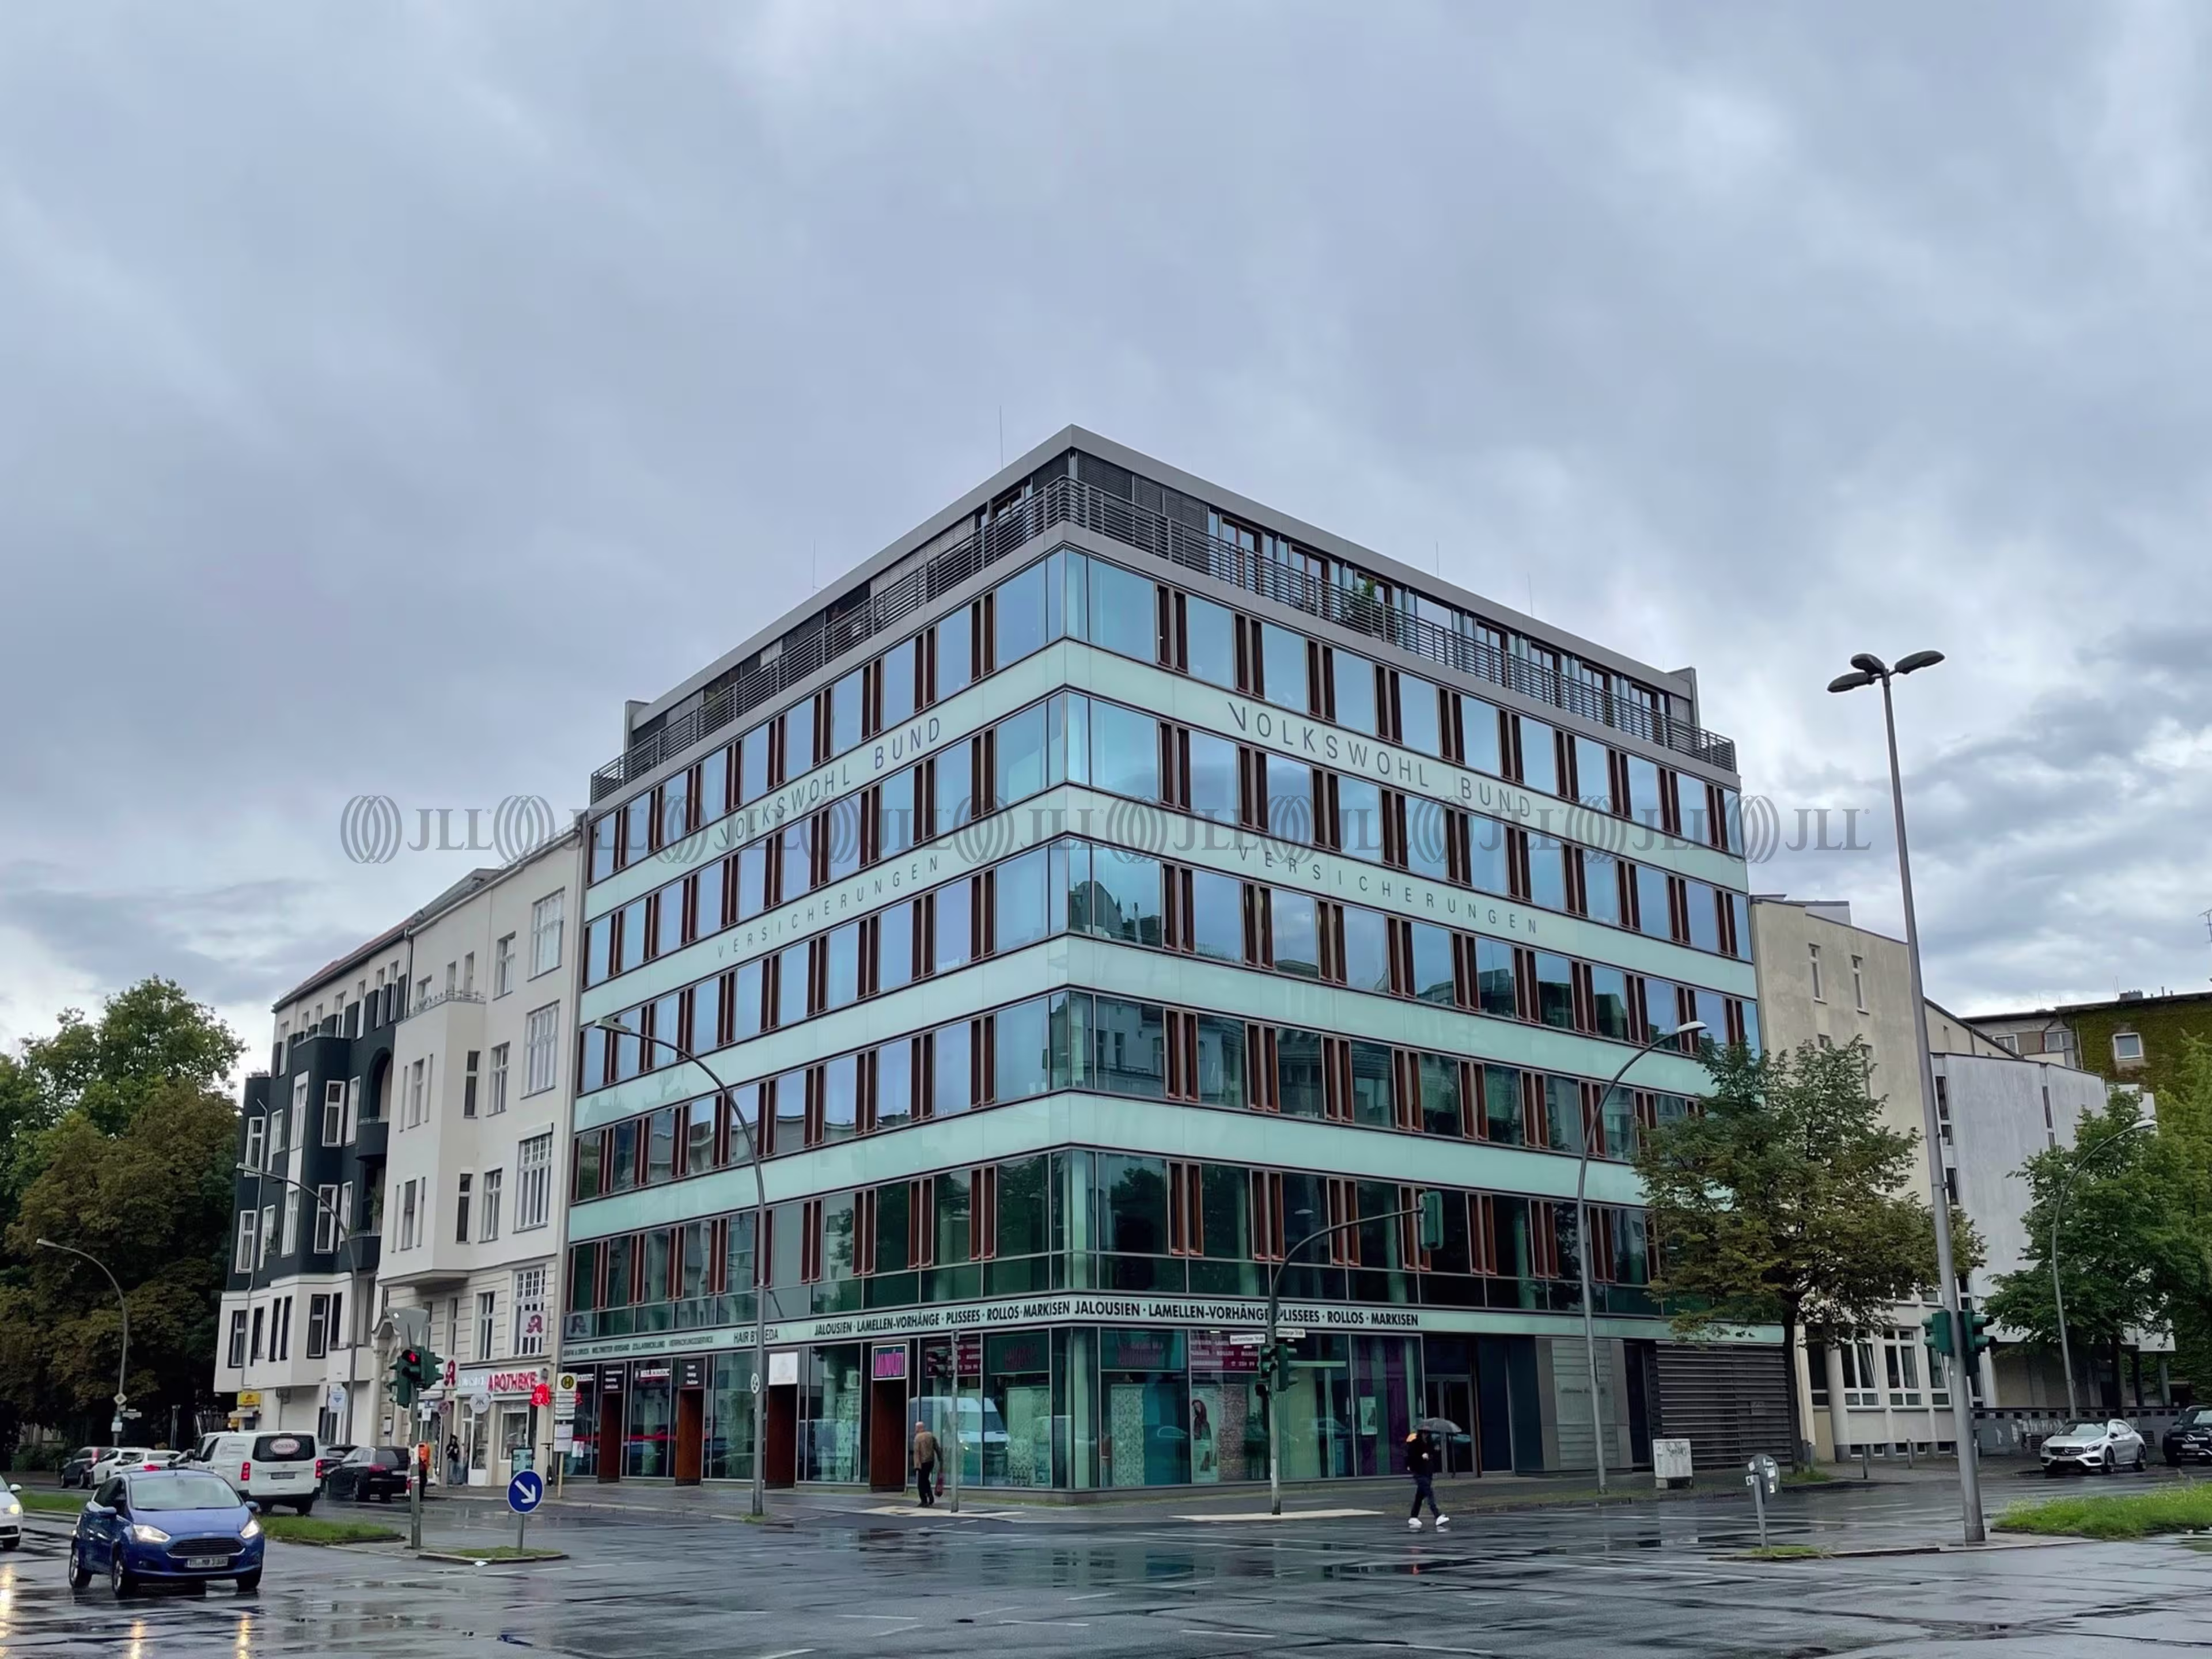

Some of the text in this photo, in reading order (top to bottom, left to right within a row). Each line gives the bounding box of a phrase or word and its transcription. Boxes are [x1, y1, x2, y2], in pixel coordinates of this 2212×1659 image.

[719, 717, 940, 846] VOLKSWOHL BUND
[1228, 702, 1531, 817] VOLKSWOHL BUND
[718, 855, 938, 959] VERSICHERUNGEN
[1238, 845, 1537, 934] VERSICHERUNGEN
[733, 1331, 749, 1344] HAIR
[814, 1301, 1070, 1336] JALOUSIEN LAMELLEN-VORHÄNGE PLISSEES ROLLOS MARKISEN
[1075, 1301, 1140, 1316] JALOUSIEN
[1327, 1311, 1364, 1324] ROLLOS
[1371, 1312, 1419, 1326] MARKISEN
[487, 1371, 537, 1392] APOTHEKE
